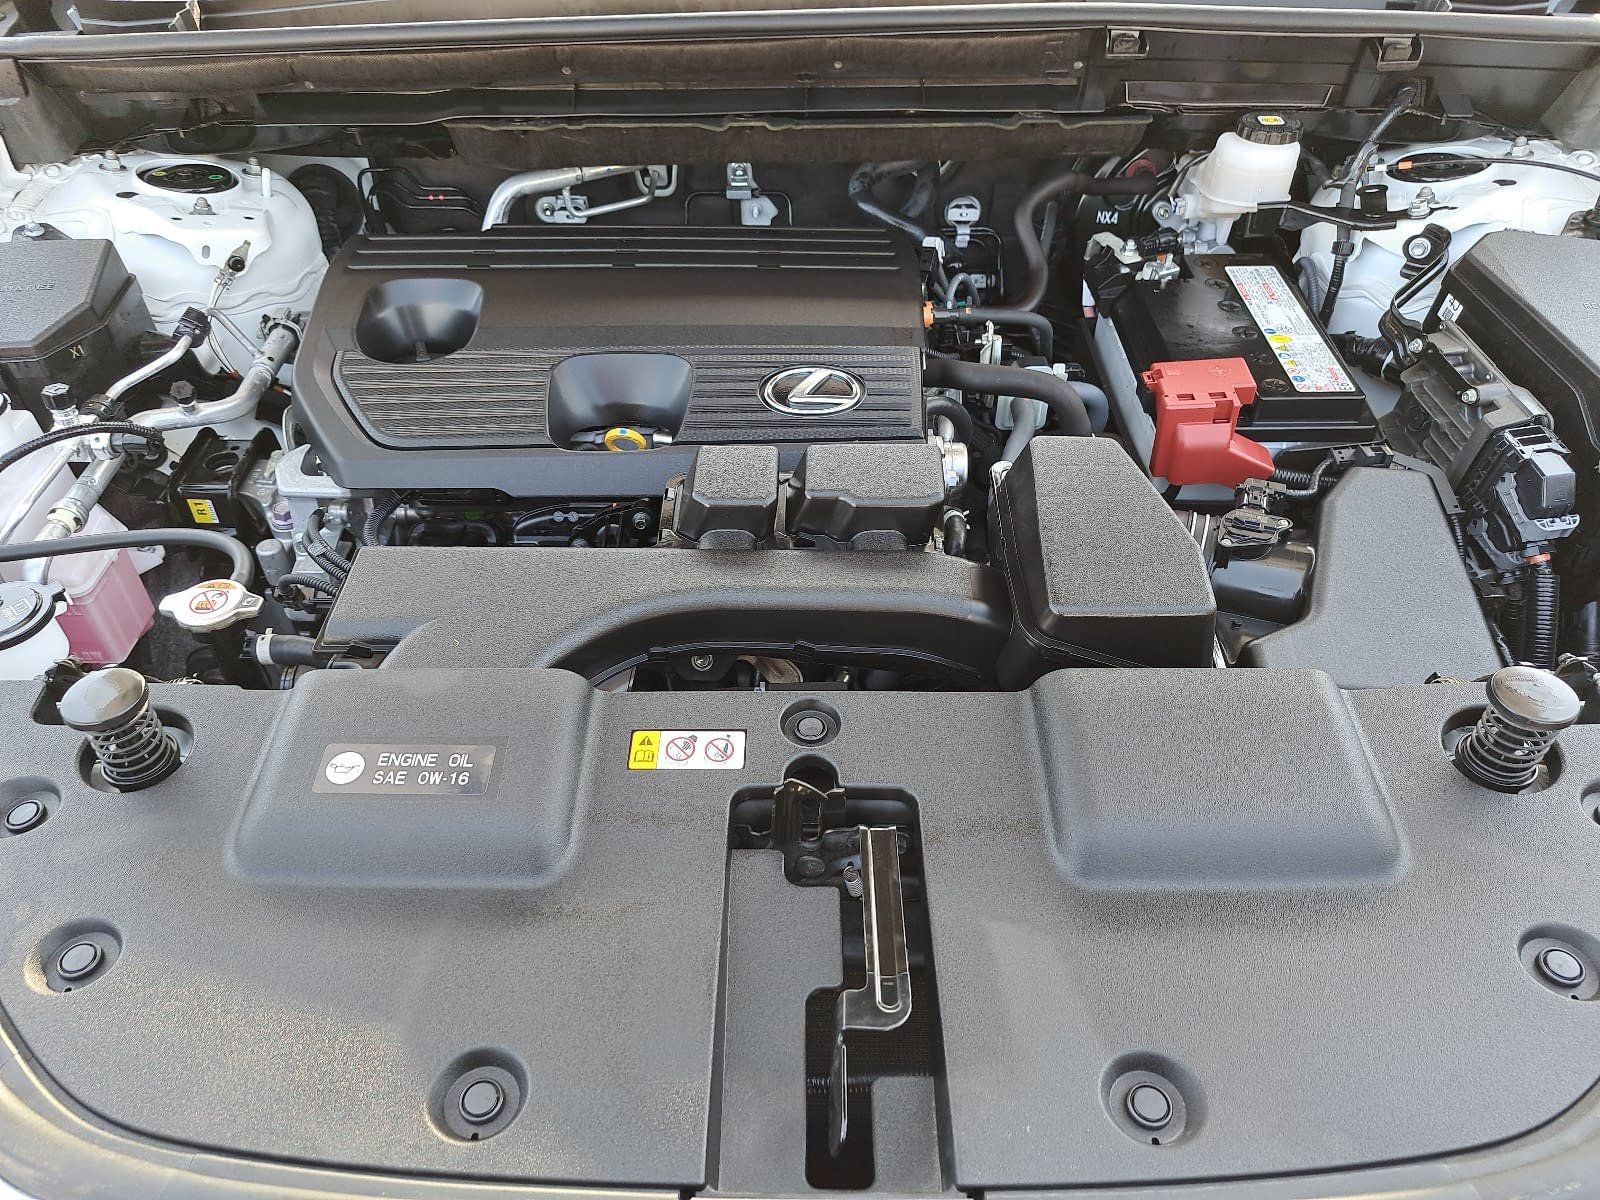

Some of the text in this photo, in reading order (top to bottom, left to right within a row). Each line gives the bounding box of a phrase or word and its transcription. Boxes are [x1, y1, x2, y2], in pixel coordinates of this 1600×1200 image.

[1096, 210, 1119, 225] NX4
[1449, 298, 1461, 311] 4J
[69, 345, 85, 359] X1
[377, 752, 474, 767] ENGINE OIL
[372, 770, 408, 785] SAE
